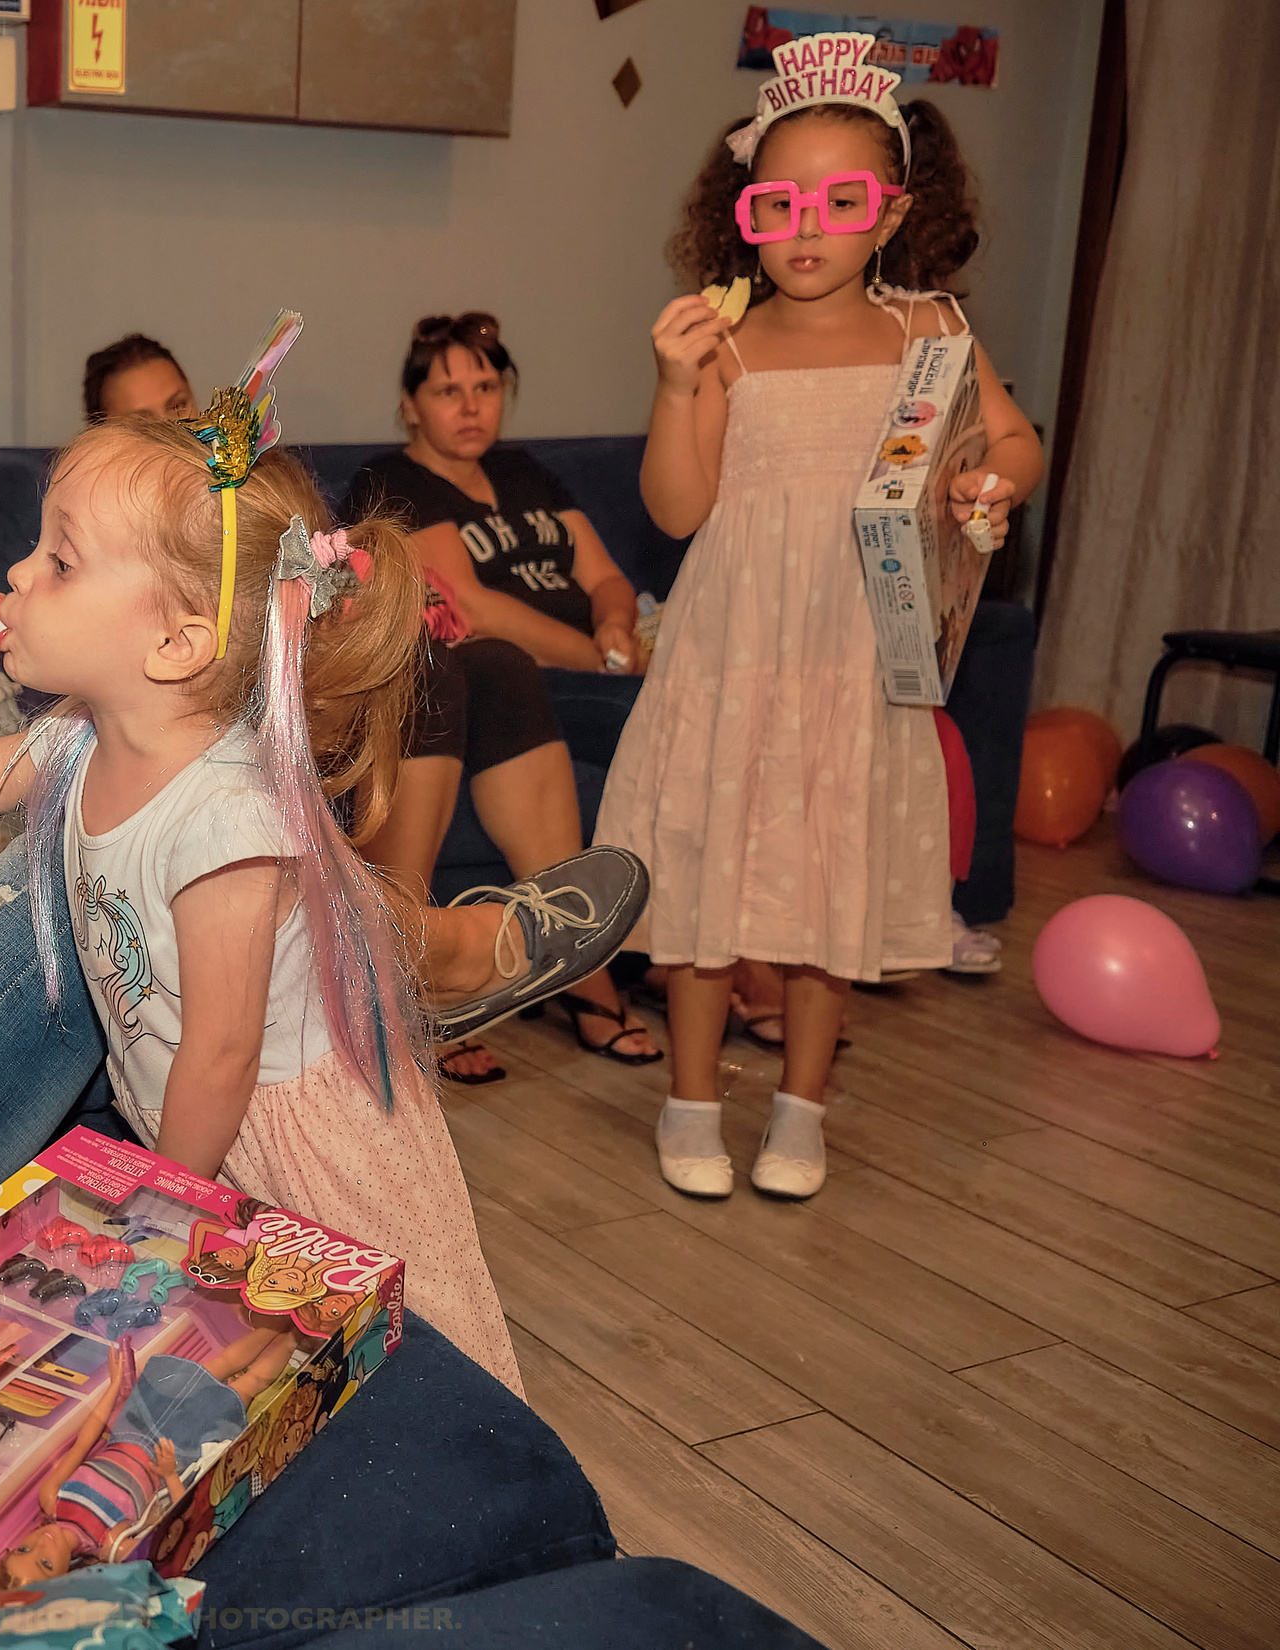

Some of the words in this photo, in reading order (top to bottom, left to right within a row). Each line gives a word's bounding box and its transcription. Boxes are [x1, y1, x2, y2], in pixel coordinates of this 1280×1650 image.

[778, 38, 870, 76] HAPPY
[764, 68, 895, 112] BIRTHDAY
[925, 348, 948, 386] FROZEN
[879, 516, 893, 548] FROZEN
[106, 1156, 147, 1178] ATTENTION:
[75, 1173, 124, 1199] ADVERTENCIA:
[152, 1175, 188, 1195] WARNING:
[218, 1194, 232, 1203] 3+
[254, 1211, 400, 1294] Barbie
[382, 1274, 404, 1352] Barbie
